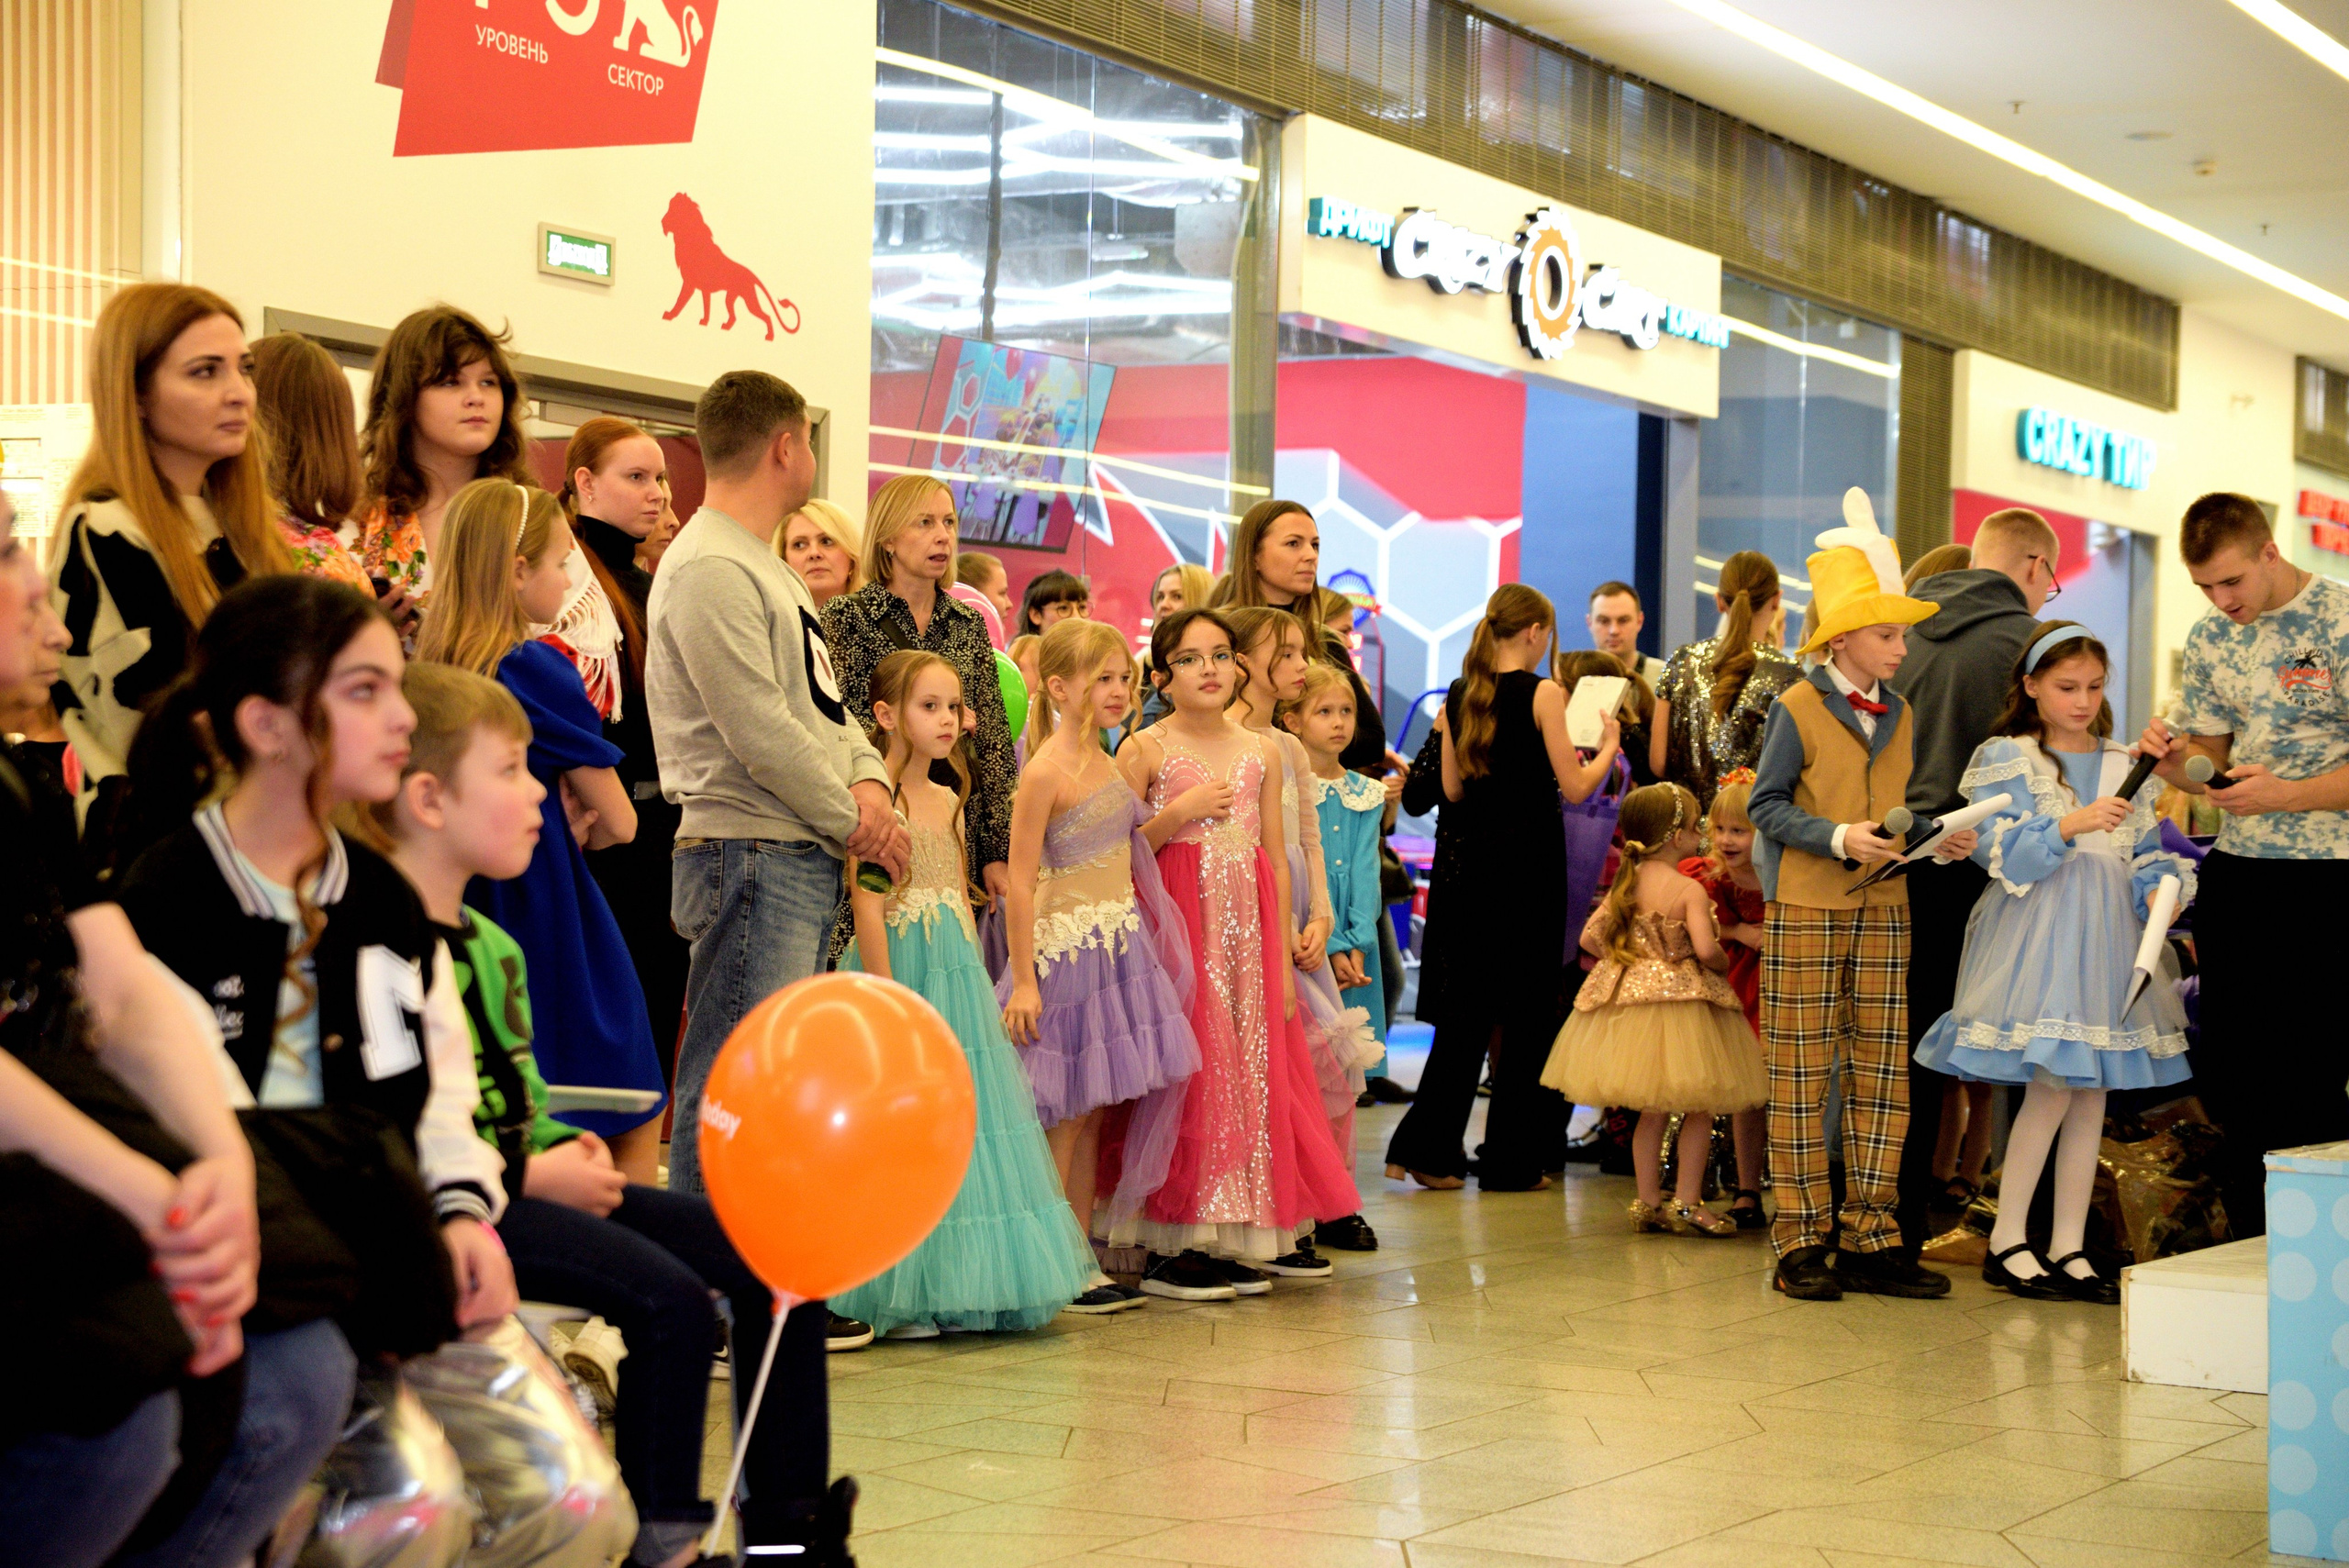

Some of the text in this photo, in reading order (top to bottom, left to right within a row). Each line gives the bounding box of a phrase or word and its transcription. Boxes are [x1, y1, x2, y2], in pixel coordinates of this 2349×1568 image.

[475, 24, 549, 64] УРОВЕНЬ
[607, 63, 664, 96] СЕКТОР
[1319, 195, 1395, 249] ДРИФТ
[2023, 405, 2106, 479] CRAZY
[2284, 647, 2309, 664] CHILL
[2284, 690, 2331, 707] PARADISE
